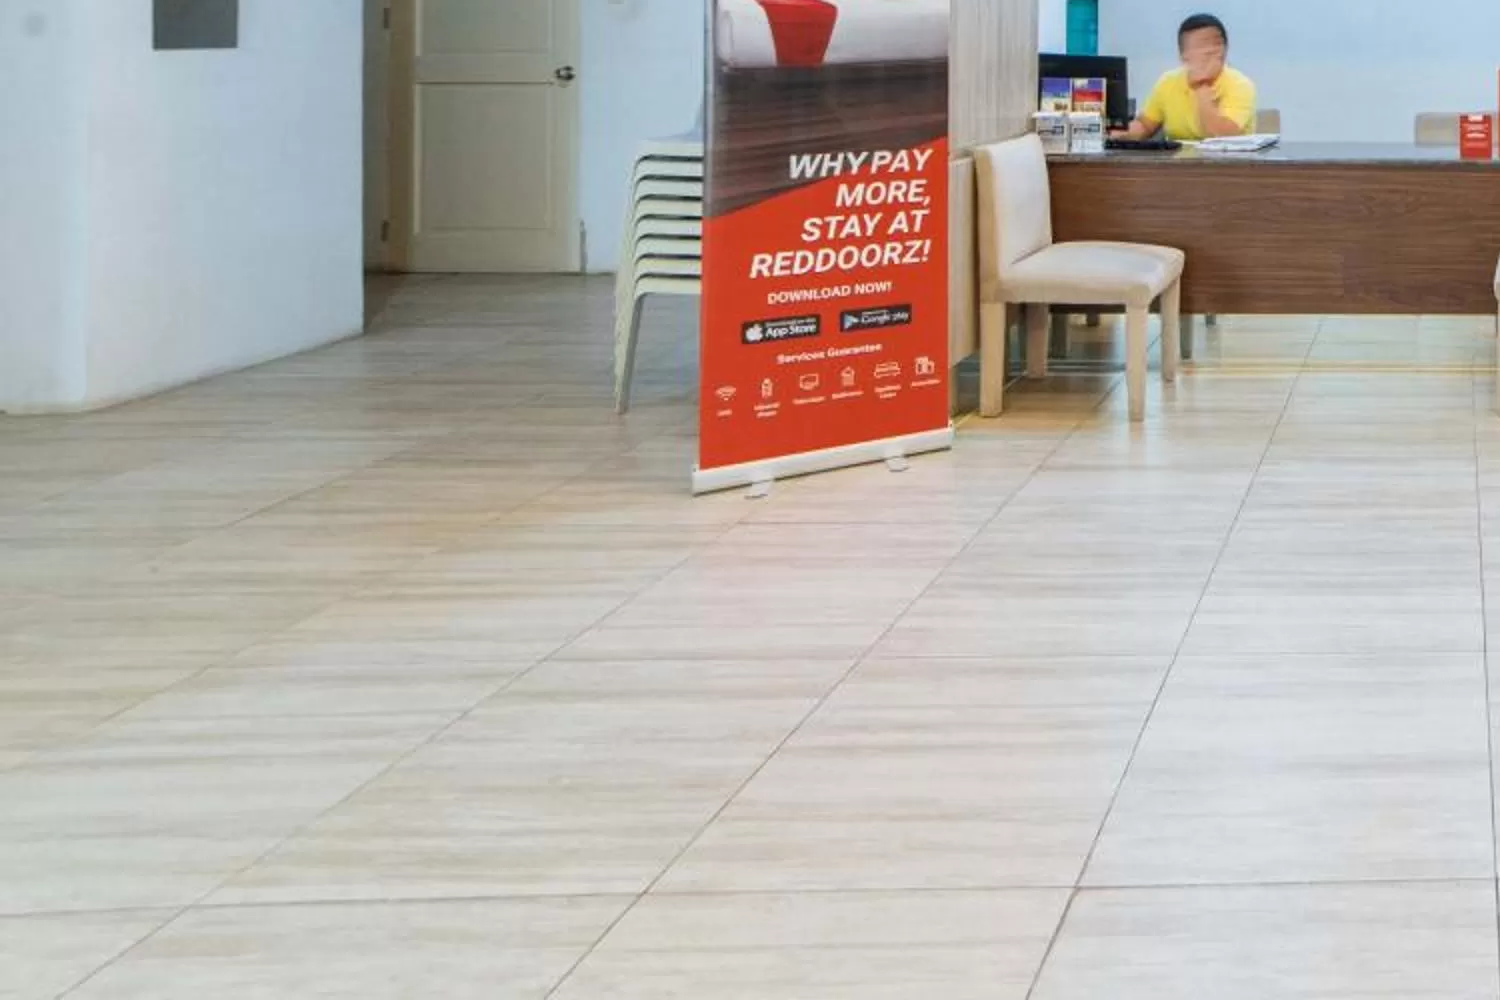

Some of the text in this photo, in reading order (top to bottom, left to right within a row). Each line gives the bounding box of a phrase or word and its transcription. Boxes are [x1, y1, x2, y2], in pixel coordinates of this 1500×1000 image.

[789, 149, 934, 179] WHY PAY
[836, 179, 931, 208] MORE,
[801, 209, 930, 242] STAY AT
[750, 240, 932, 279] REDDOORZ!
[767, 281, 893, 305] DOWNLOAD NOW!
[765, 327, 789, 339] App
